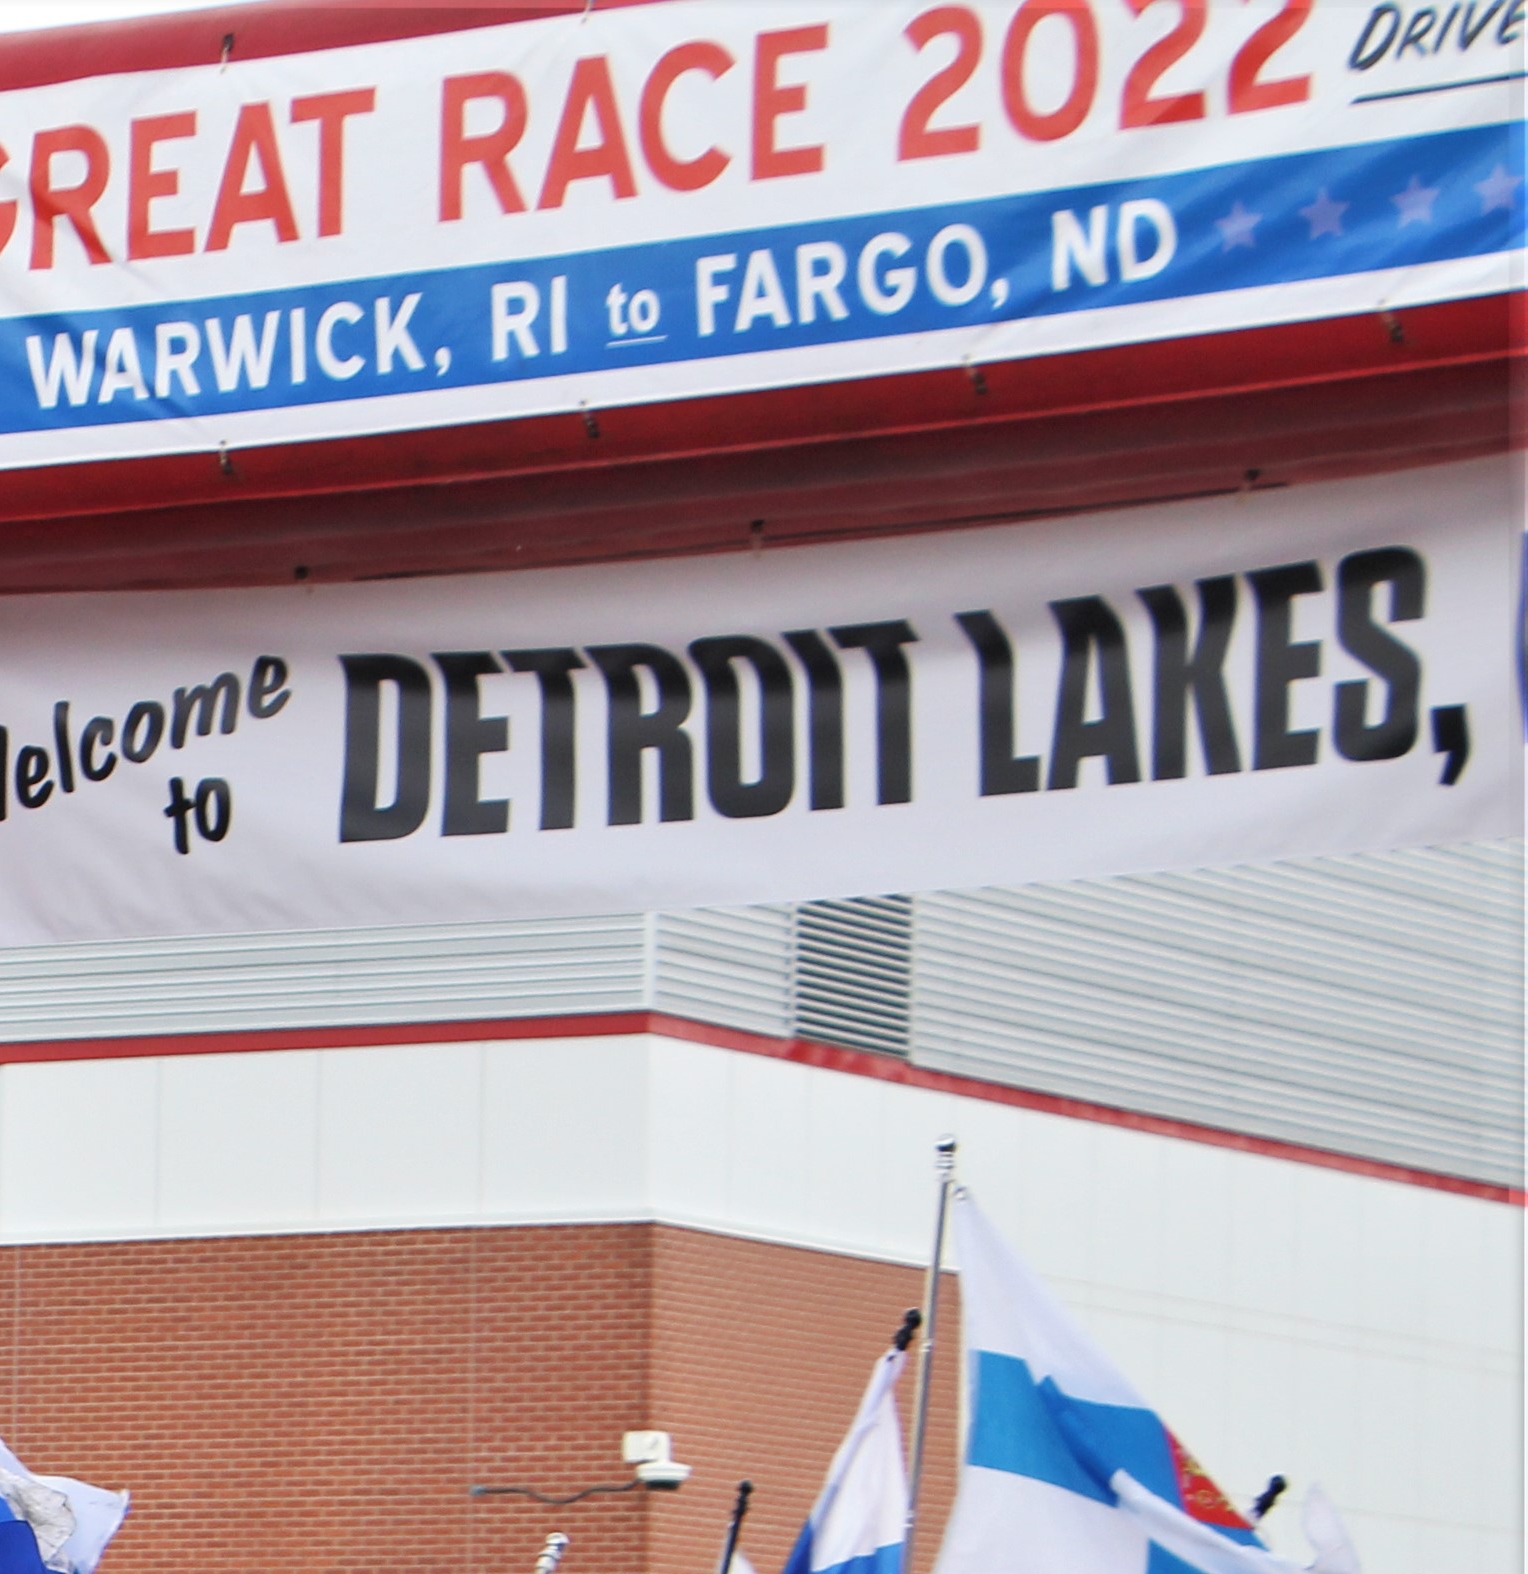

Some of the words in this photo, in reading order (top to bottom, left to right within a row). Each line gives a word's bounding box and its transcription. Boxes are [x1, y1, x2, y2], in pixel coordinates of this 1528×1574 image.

[436, 22, 829, 223] RACE
[896, 0, 1313, 163] 2022
[26, 291, 452, 409] WARWICK,
[490, 273, 568, 362] RI
[607, 279, 661, 338] to
[696, 223, 1009, 338] FARGO,
[1051, 198, 1178, 293] ND
[337, 618, 920, 845] DETROIT
[951, 544, 1471, 798] LAKES,
[164, 771, 233, 856] to
